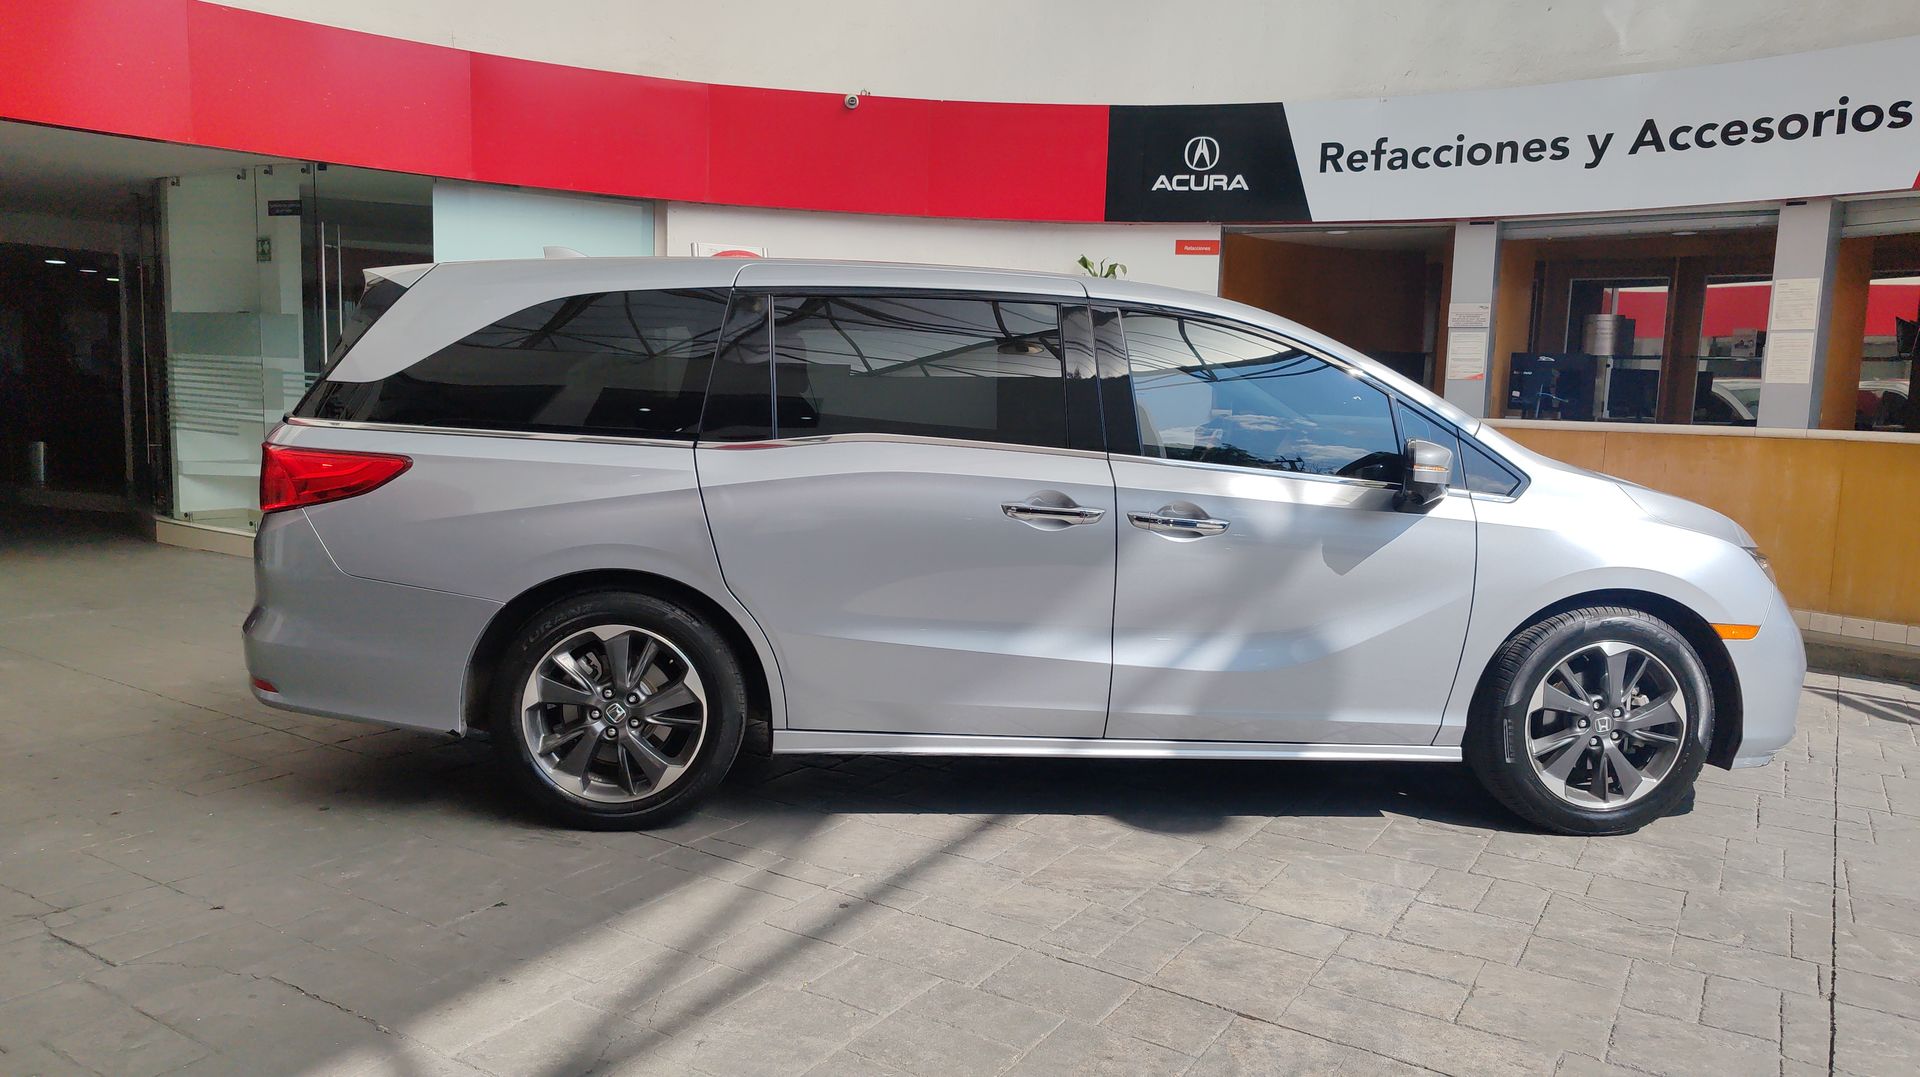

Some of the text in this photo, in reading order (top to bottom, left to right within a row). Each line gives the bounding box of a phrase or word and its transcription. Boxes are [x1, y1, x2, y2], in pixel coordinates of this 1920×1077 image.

[1319, 95, 1913, 174] Refacciones y Accesorios
[1151, 174, 1249, 191] ACURA
